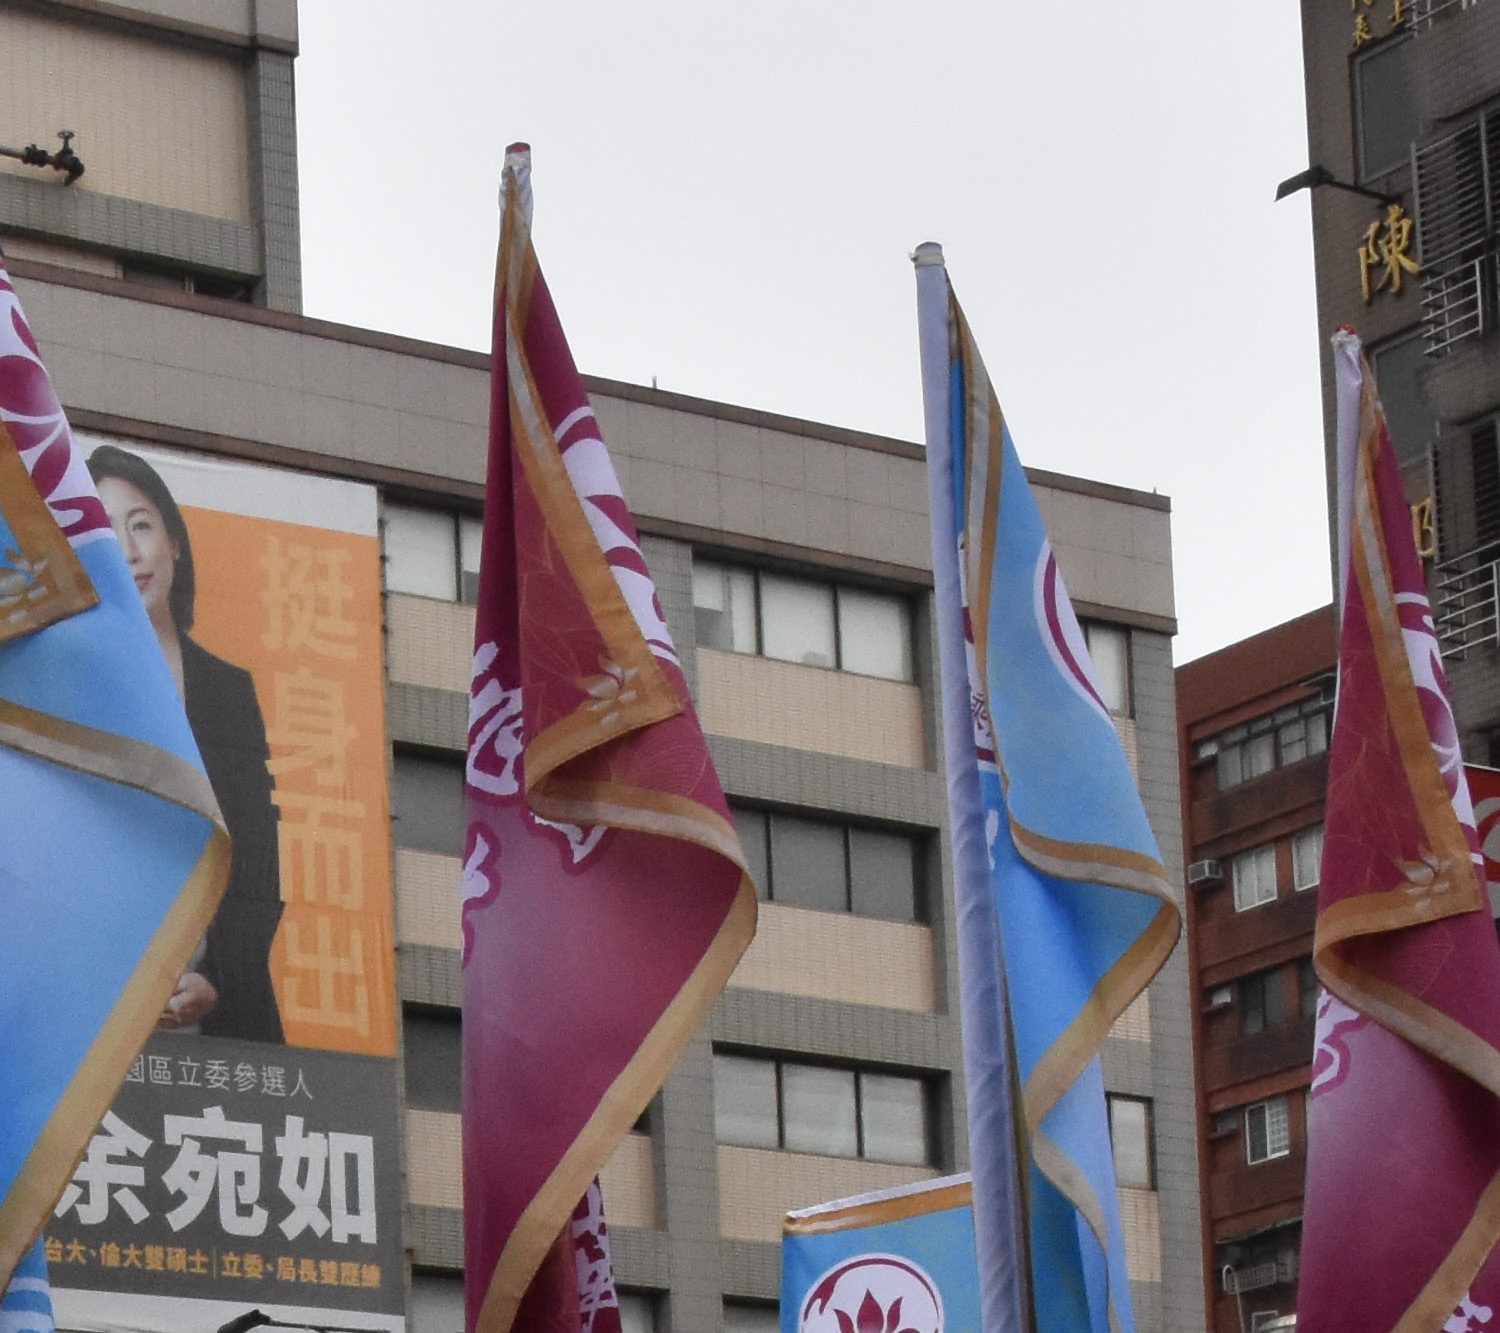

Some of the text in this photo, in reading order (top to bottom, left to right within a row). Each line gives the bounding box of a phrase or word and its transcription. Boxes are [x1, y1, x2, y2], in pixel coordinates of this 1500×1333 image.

[256, 536, 370, 1041] 挺身而出
[54, 1105, 378, 1245] 余宛如
